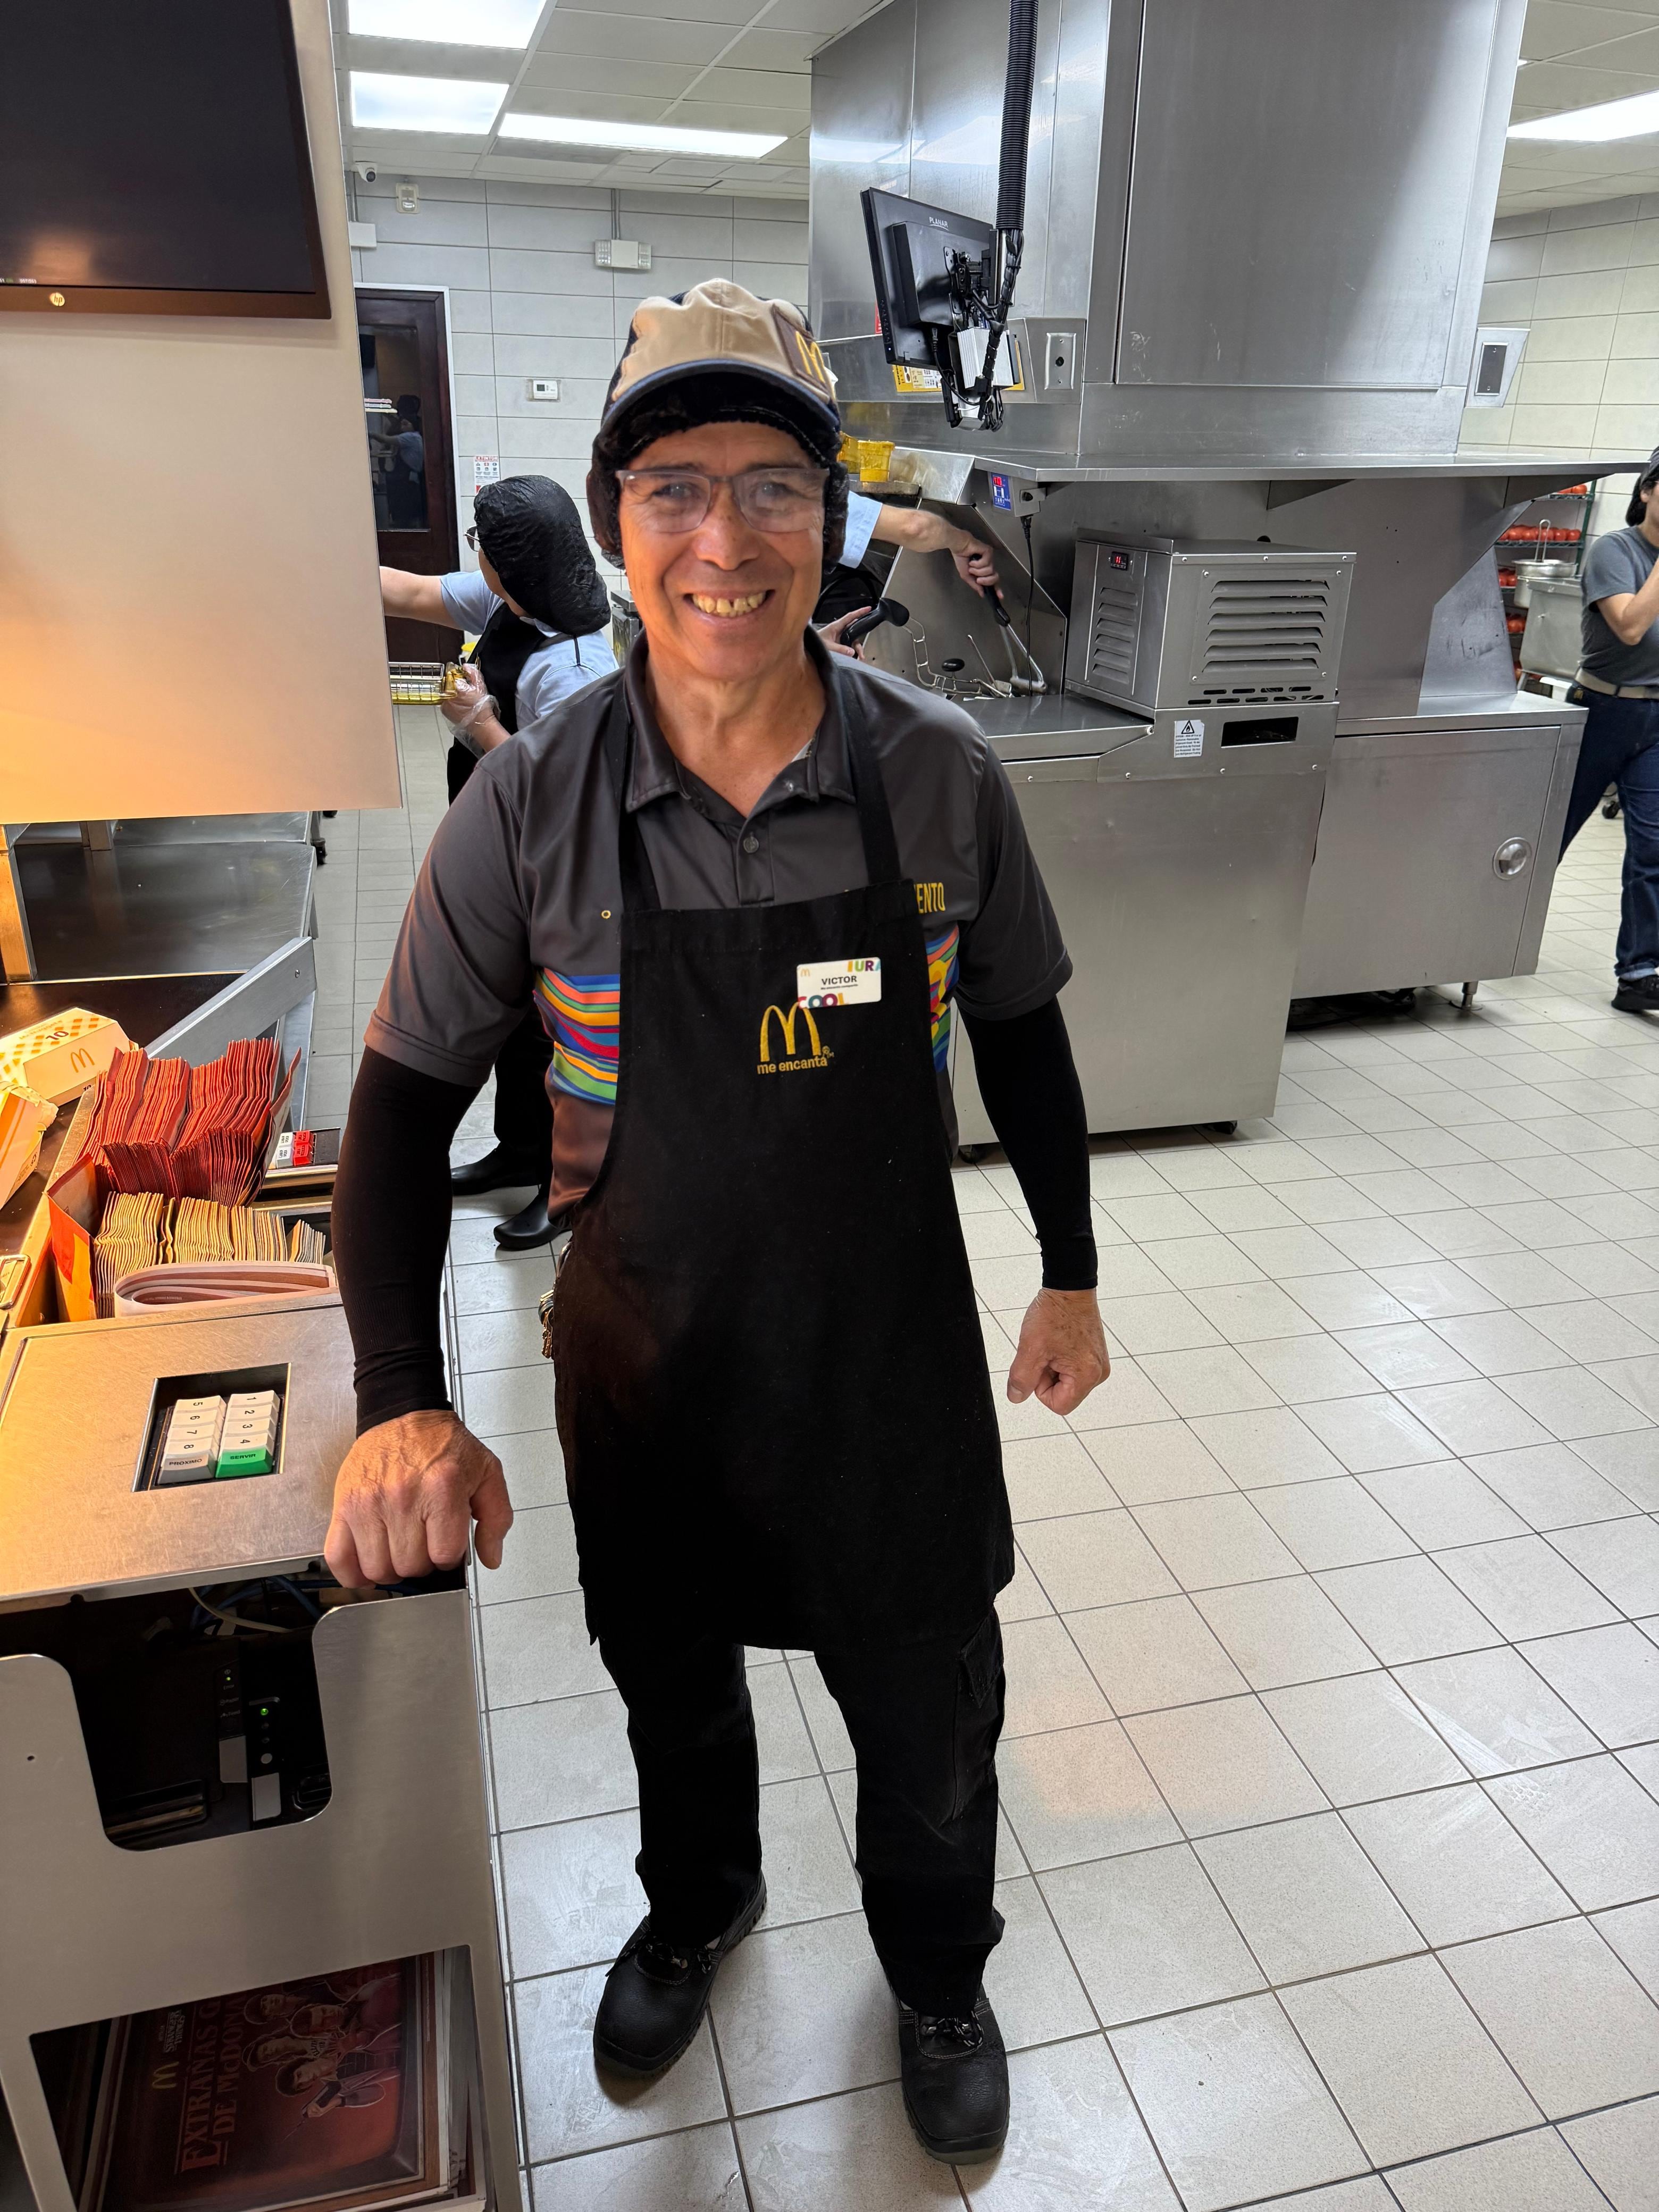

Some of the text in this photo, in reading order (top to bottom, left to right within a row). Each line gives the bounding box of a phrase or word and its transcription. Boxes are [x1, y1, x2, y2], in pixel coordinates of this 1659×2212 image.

[914, 882, 945, 914] ENTO
[822, 975, 857, 985] VICTOR
[46, 1030, 69, 1040] 10
[757, 1055, 828, 1074] me encanta
[181, 2025, 222, 2172] EXTRAÑAS
[212, 2099, 237, 2136] DE
